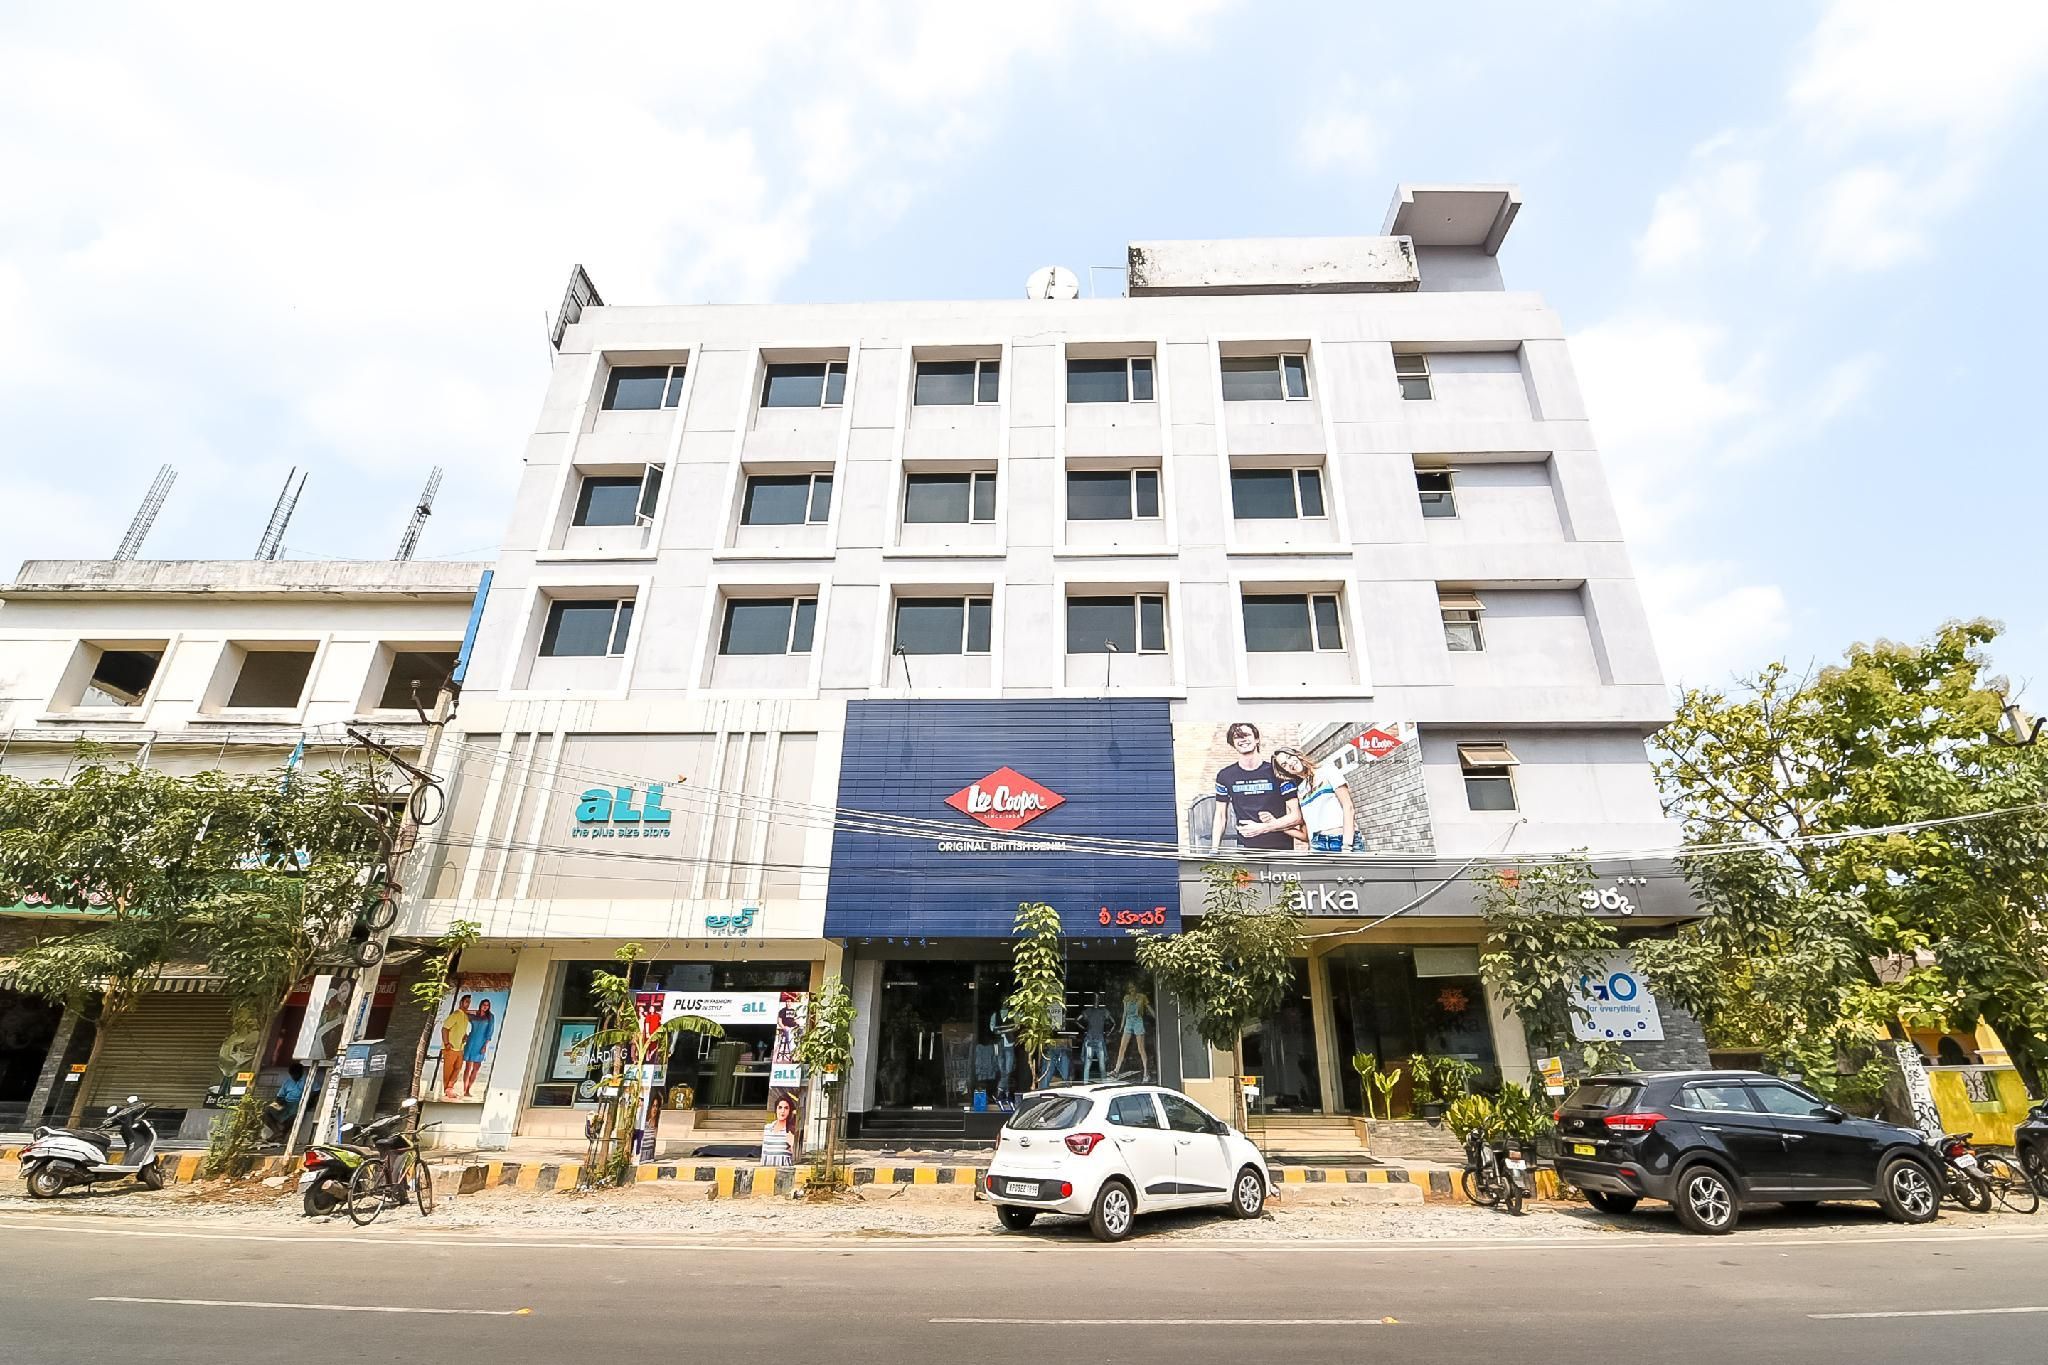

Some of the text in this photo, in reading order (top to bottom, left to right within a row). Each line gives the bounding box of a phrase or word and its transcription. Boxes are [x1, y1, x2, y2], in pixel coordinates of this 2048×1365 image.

[967, 785, 1047, 817] Lee Cooper
[572, 827, 670, 840] the plus size store
[938, 842, 987, 852] ORIGINAL
[991, 842, 1032, 851] BRITISH
[1260, 871, 1302, 883] Hotel
[1288, 884, 1359, 911] arka
[673, 999, 703, 1011] PLUS
[1600, 1005, 1642, 1013] everything
